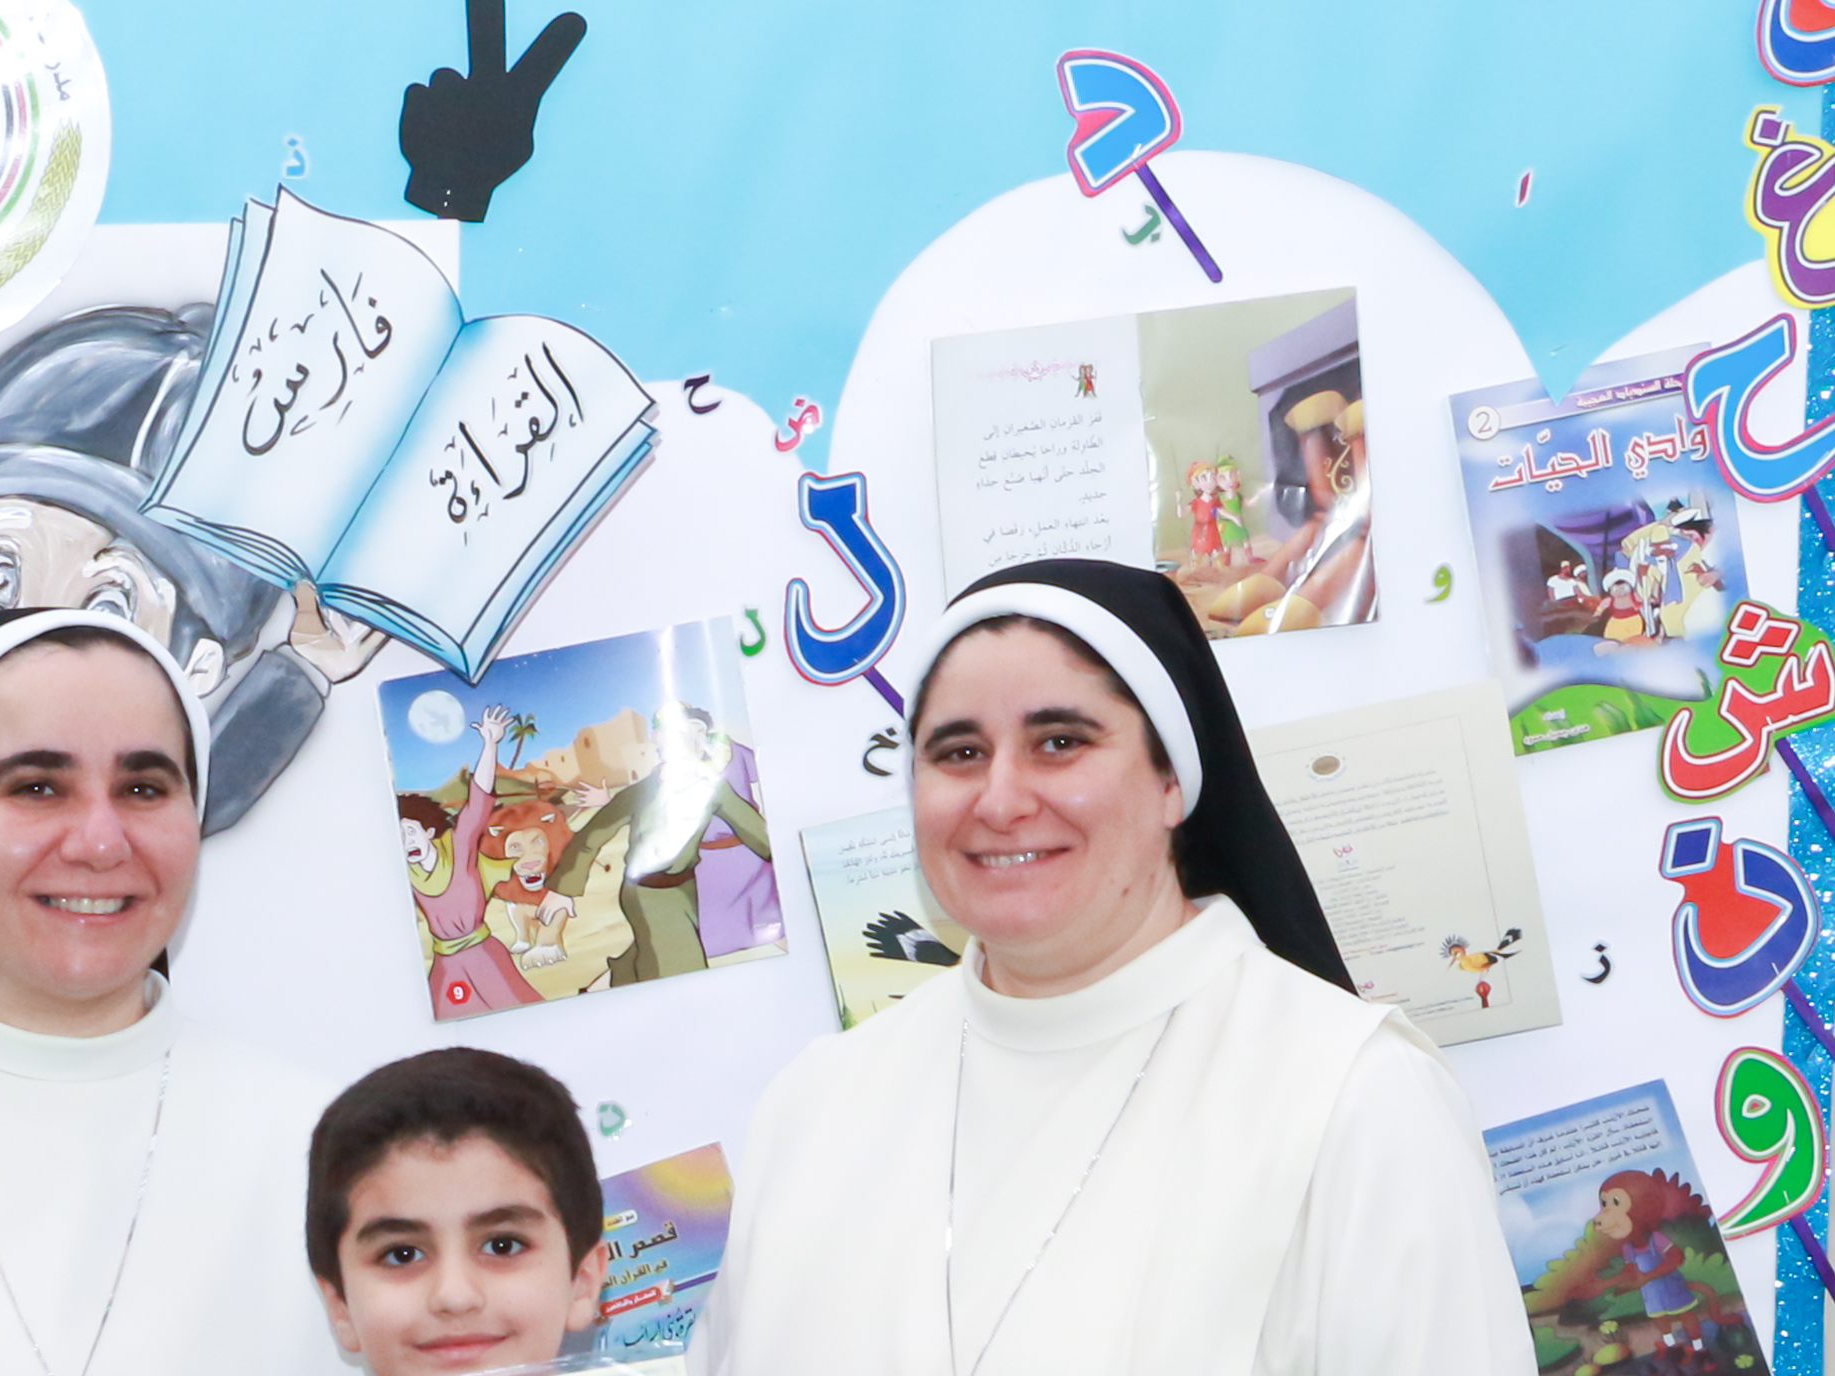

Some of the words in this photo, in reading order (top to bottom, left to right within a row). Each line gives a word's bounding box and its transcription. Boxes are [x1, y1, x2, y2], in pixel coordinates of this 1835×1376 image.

[1056, 48, 1181, 197] د
[1474, 410, 1493, 435] 2
[1624, 413, 1711, 480] وادي
[783, 471, 907, 687] ل
[1425, 565, 1453, 603] و
[1657, 600, 1835, 804] ش
[862, 726, 900, 777] خ
[1659, 814, 1822, 1019] ن
[452, 985, 464, 1001] 9
[1581, 942, 1612, 984] ز
[1714, 1045, 1828, 1241] و
